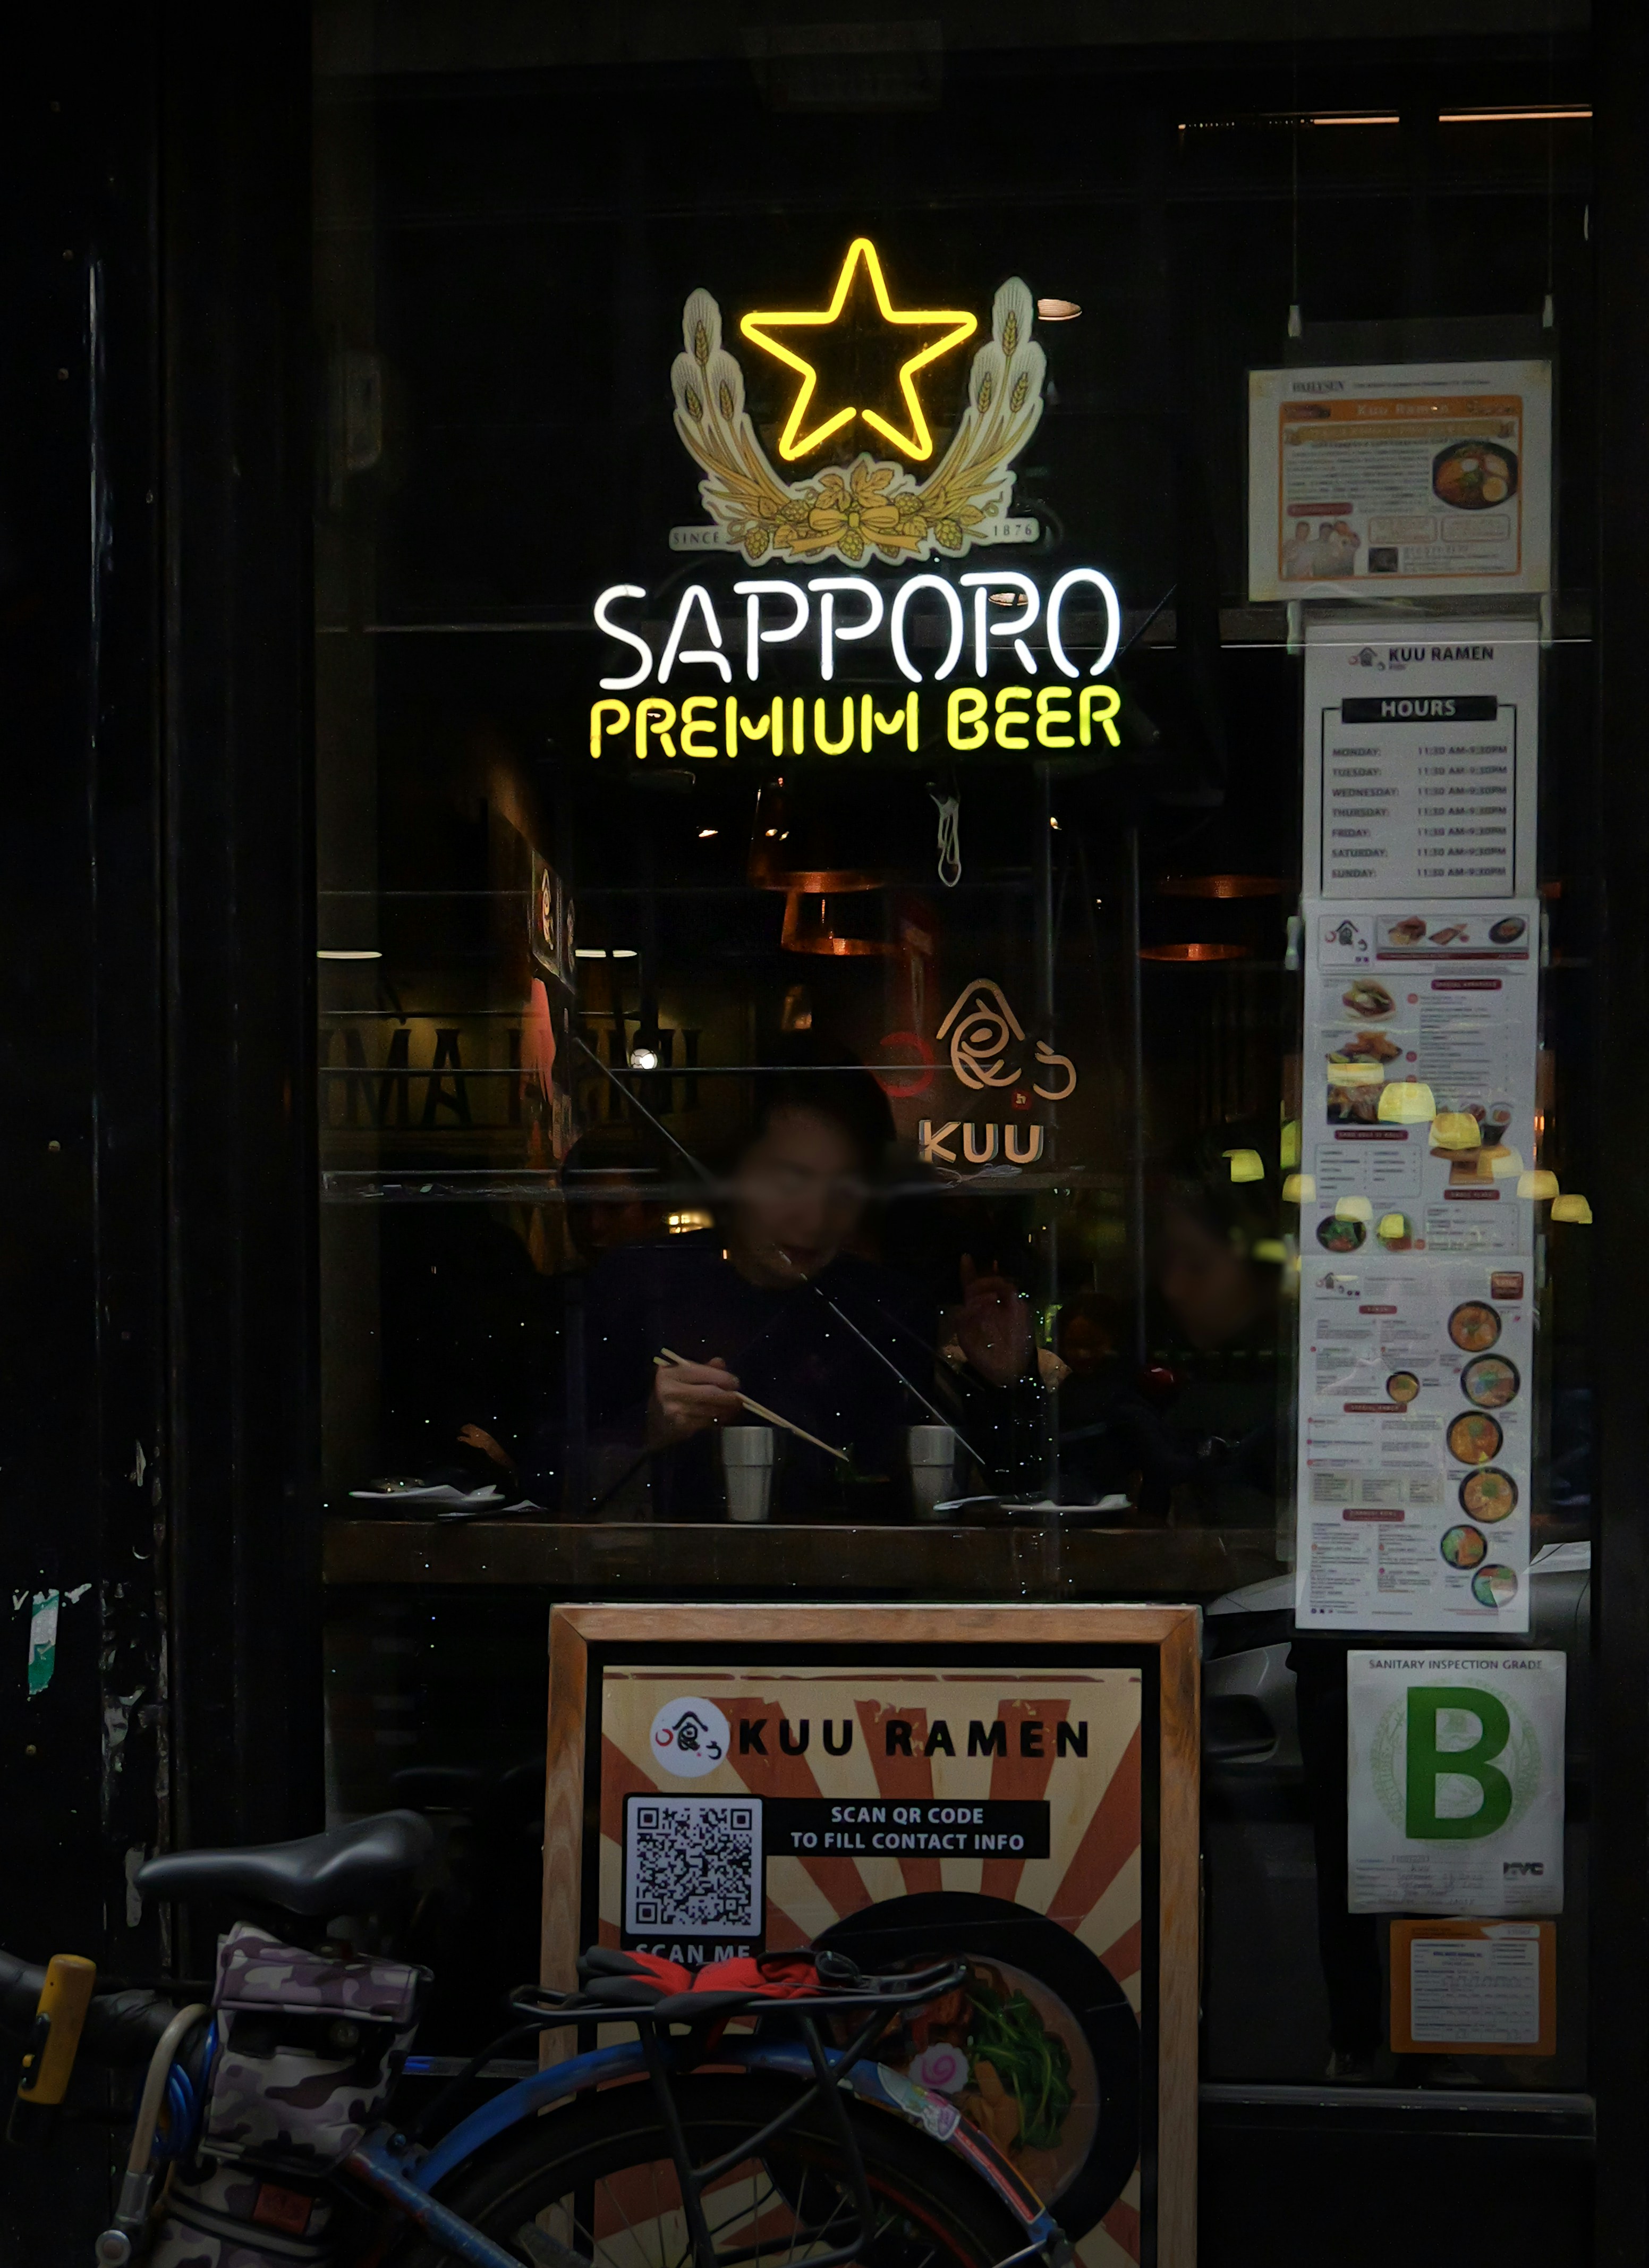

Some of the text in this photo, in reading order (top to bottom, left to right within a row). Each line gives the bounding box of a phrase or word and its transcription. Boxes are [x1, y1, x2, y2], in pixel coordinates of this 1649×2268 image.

[673, 524, 1032, 544] SINCE 1876
[593, 568, 1123, 691] SAPPORO
[1389, 646, 1494, 662] KUU RAMEN
[1380, 699, 1457, 718] HOURS
[589, 684, 1122, 759] PREMIUM BEER
[919, 1119, 1044, 1164] KUU
[1369, 1660, 1542, 1670] SANITARY INSPECTION GRADE
[739, 1718, 854, 1757] KUU
[886, 1720, 1091, 1758] RAMEN
[1406, 1687, 1512, 1839] B
[831, 1806, 984, 1827] SCAN QR CODE
[792, 1832, 1025, 1852] TO FILL CONTACT INFO
